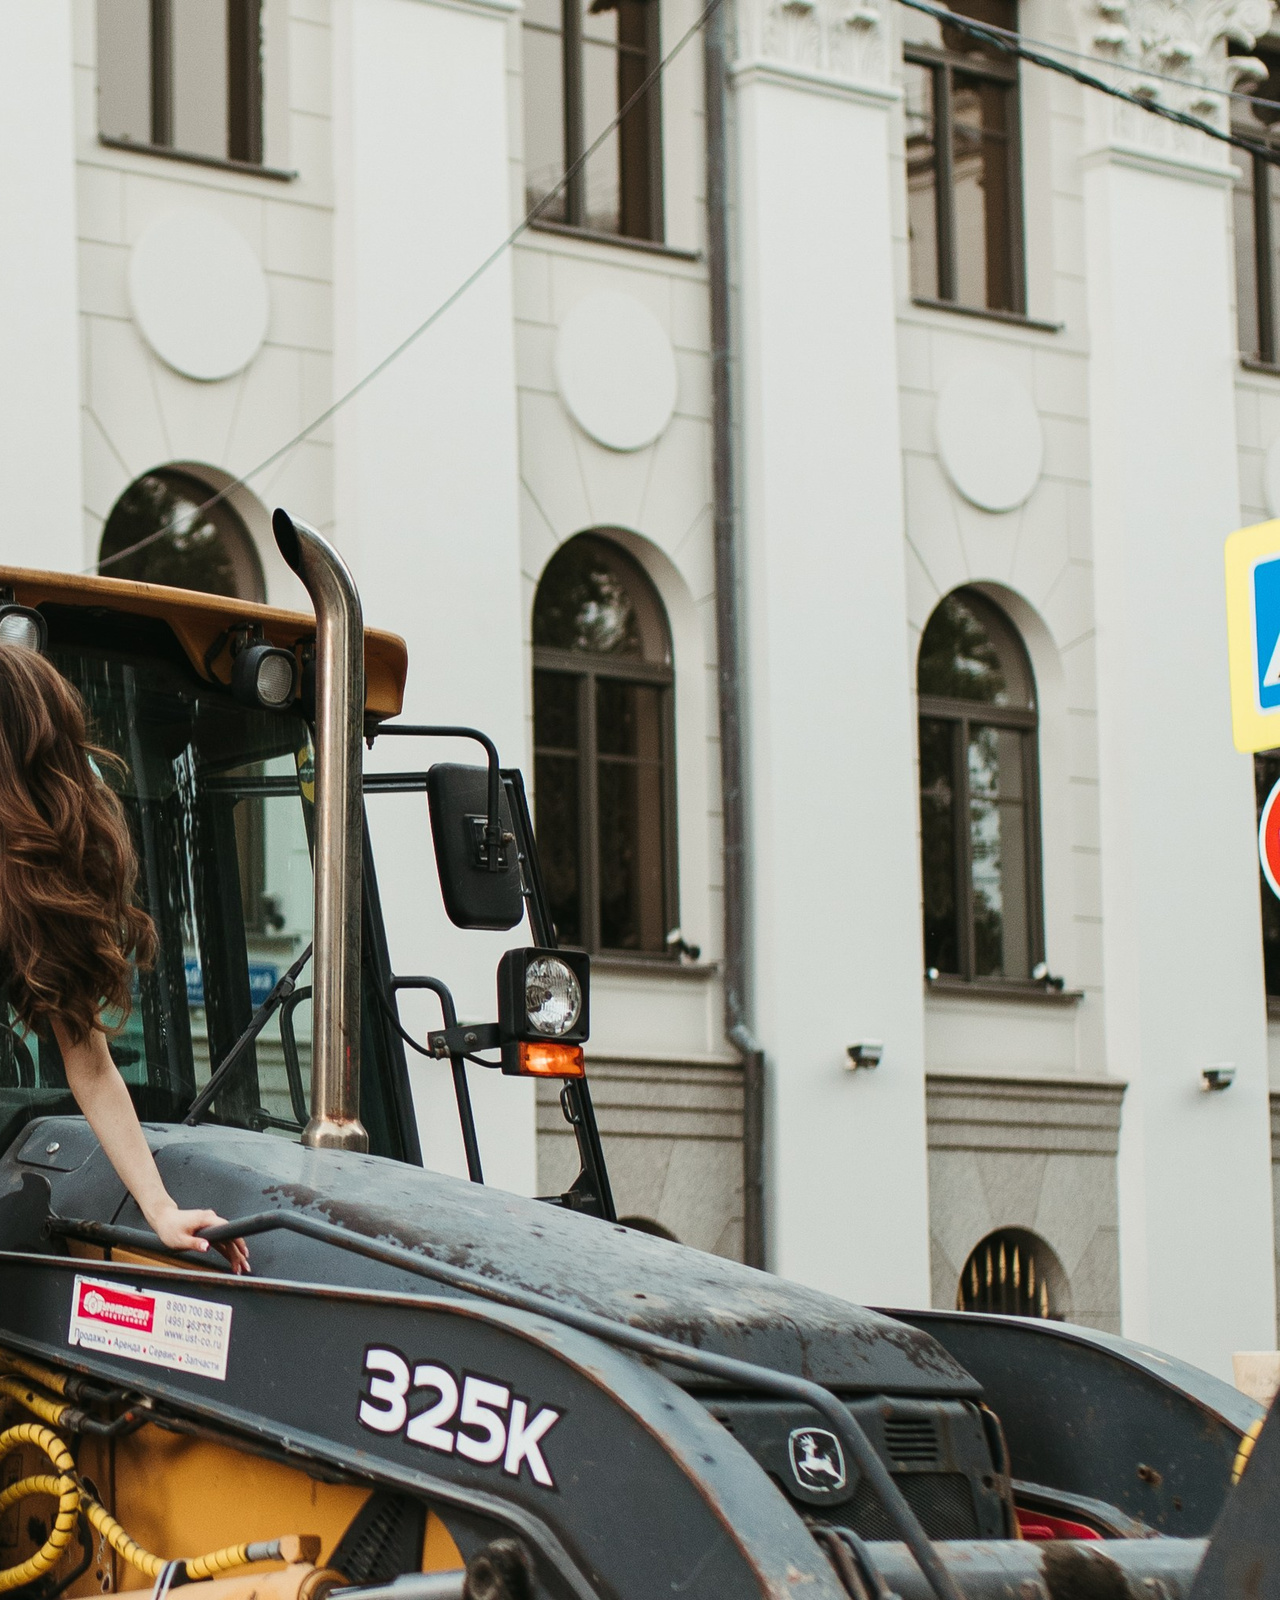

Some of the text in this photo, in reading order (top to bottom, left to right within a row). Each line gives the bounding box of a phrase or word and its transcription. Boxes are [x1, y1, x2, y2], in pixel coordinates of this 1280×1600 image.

[172, 1301, 187, 1314] 800
[189, 1305, 202, 1317] 700
[165, 1314, 185, 1328] (495)
[74, 1327, 220, 1370] Продажа Аренда Сервис Запчасти
[164, 1329, 222, 1349] www.ust-co.ru
[358, 1348, 560, 1487] 325K
